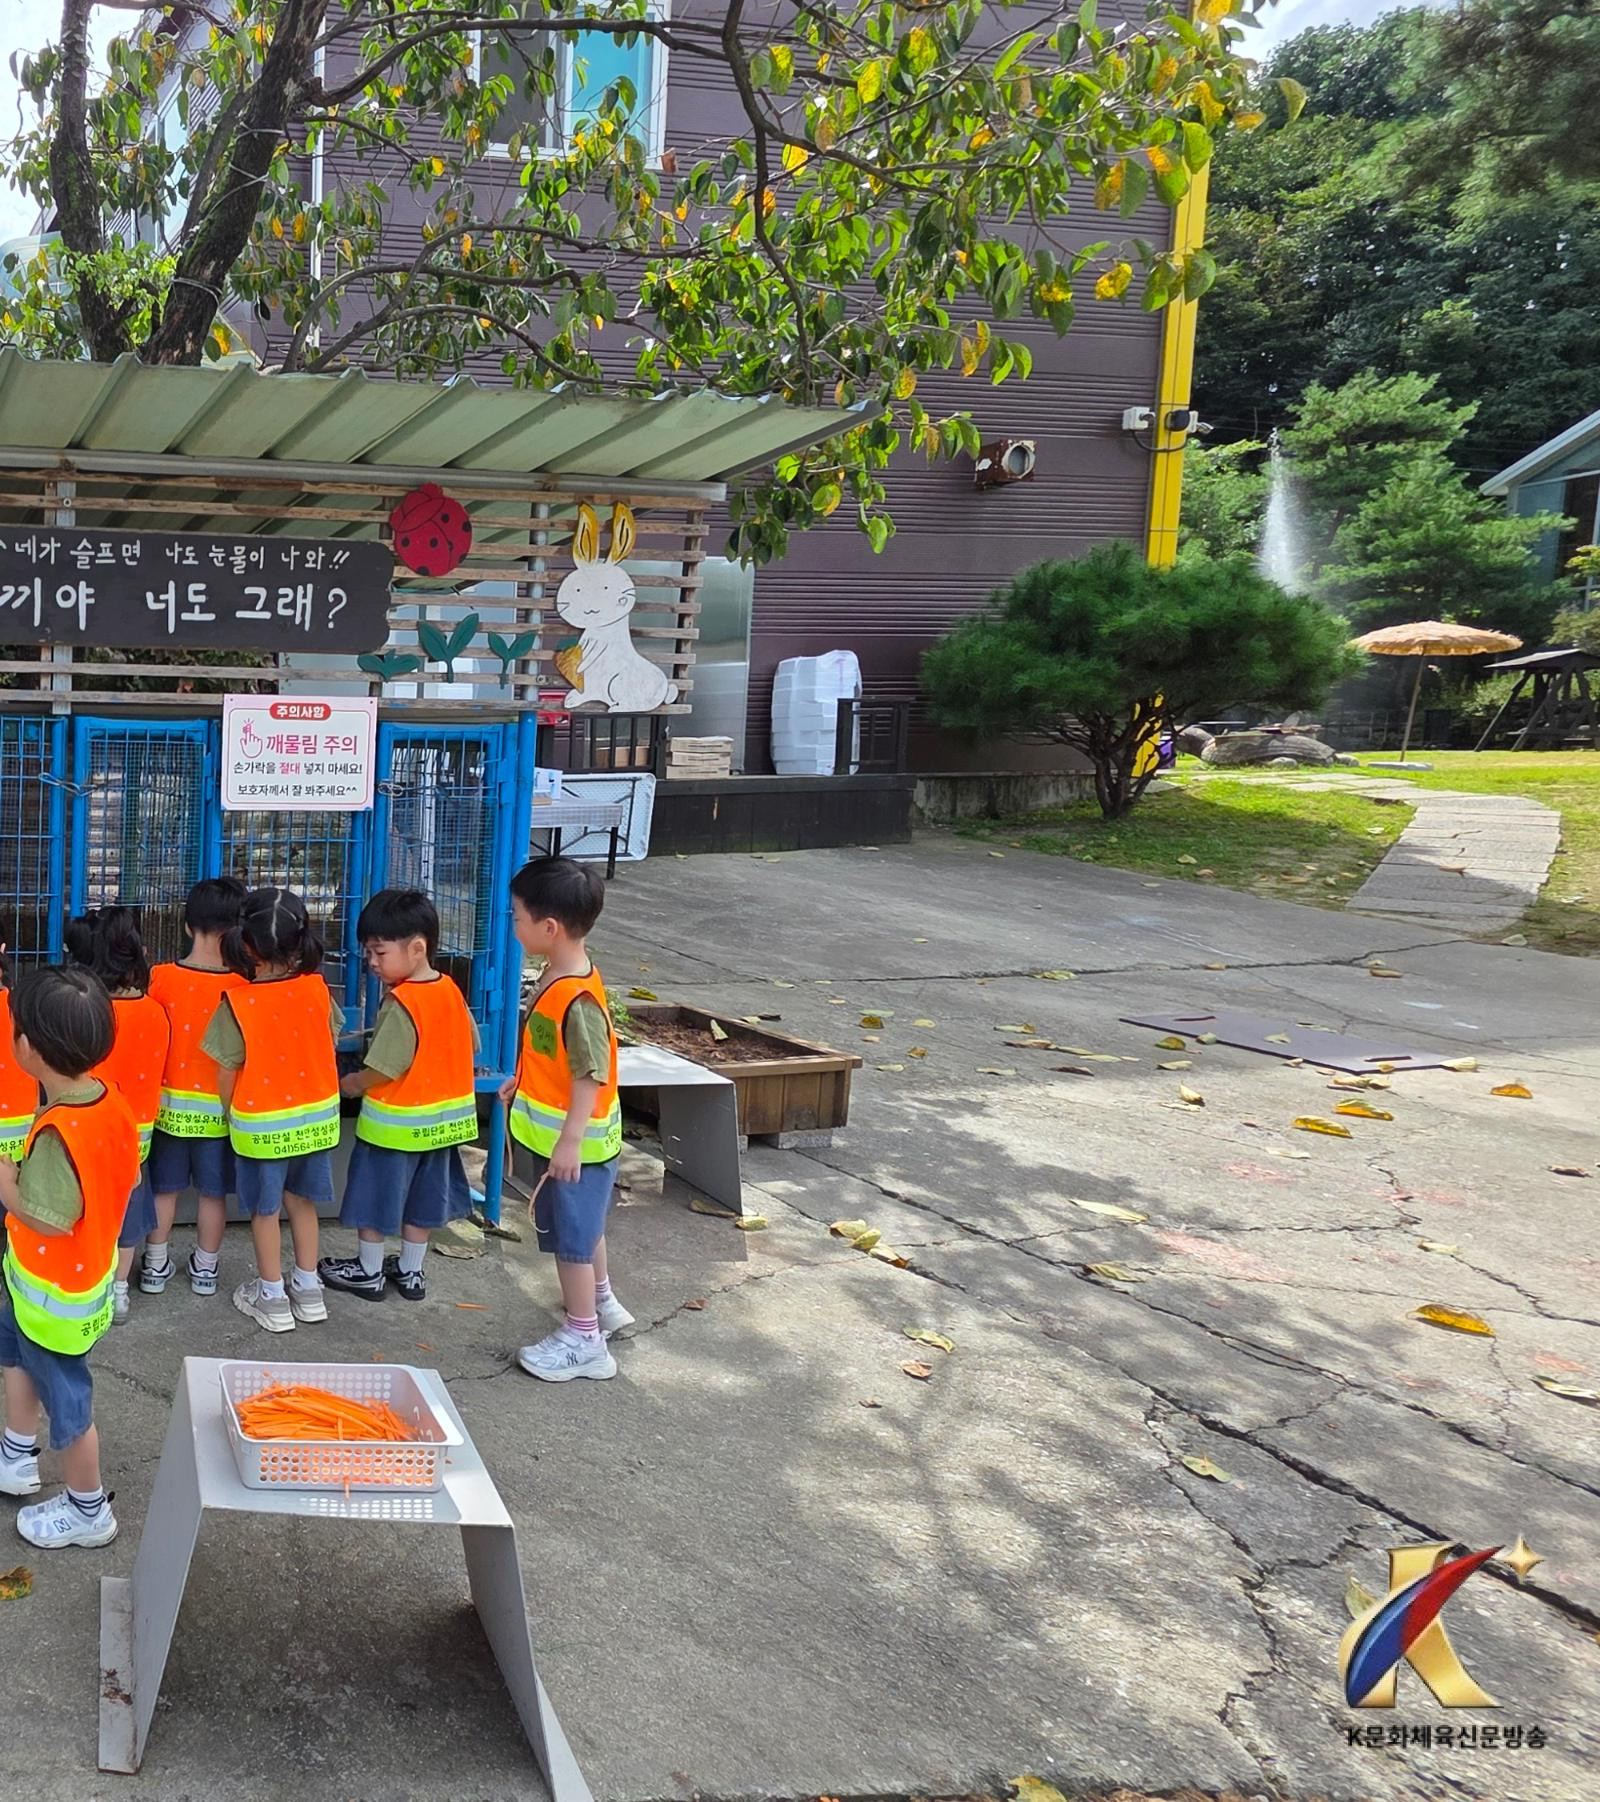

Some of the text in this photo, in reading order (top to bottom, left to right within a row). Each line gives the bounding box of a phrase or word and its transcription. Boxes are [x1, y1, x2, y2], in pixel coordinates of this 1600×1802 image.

[14, 535, 61, 564] 네가
[70, 538, 141, 569] 슬프면
[165, 542, 199, 565] 나도
[208, 545, 264, 574] 눈물이
[145, 580, 216, 634] 너도
[235, 583, 347, 631] 그래?
[277, 705, 325, 719] 주의사항
[266, 734, 358, 755] 깨물림 주의
[233, 762, 362, 775] 손가락을 절대 넣지 마세요!
[238, 784, 288, 797] 보호자께서
[292, 785, 302, 797] 잘
[252, 1132, 290, 1145] 공립단설
